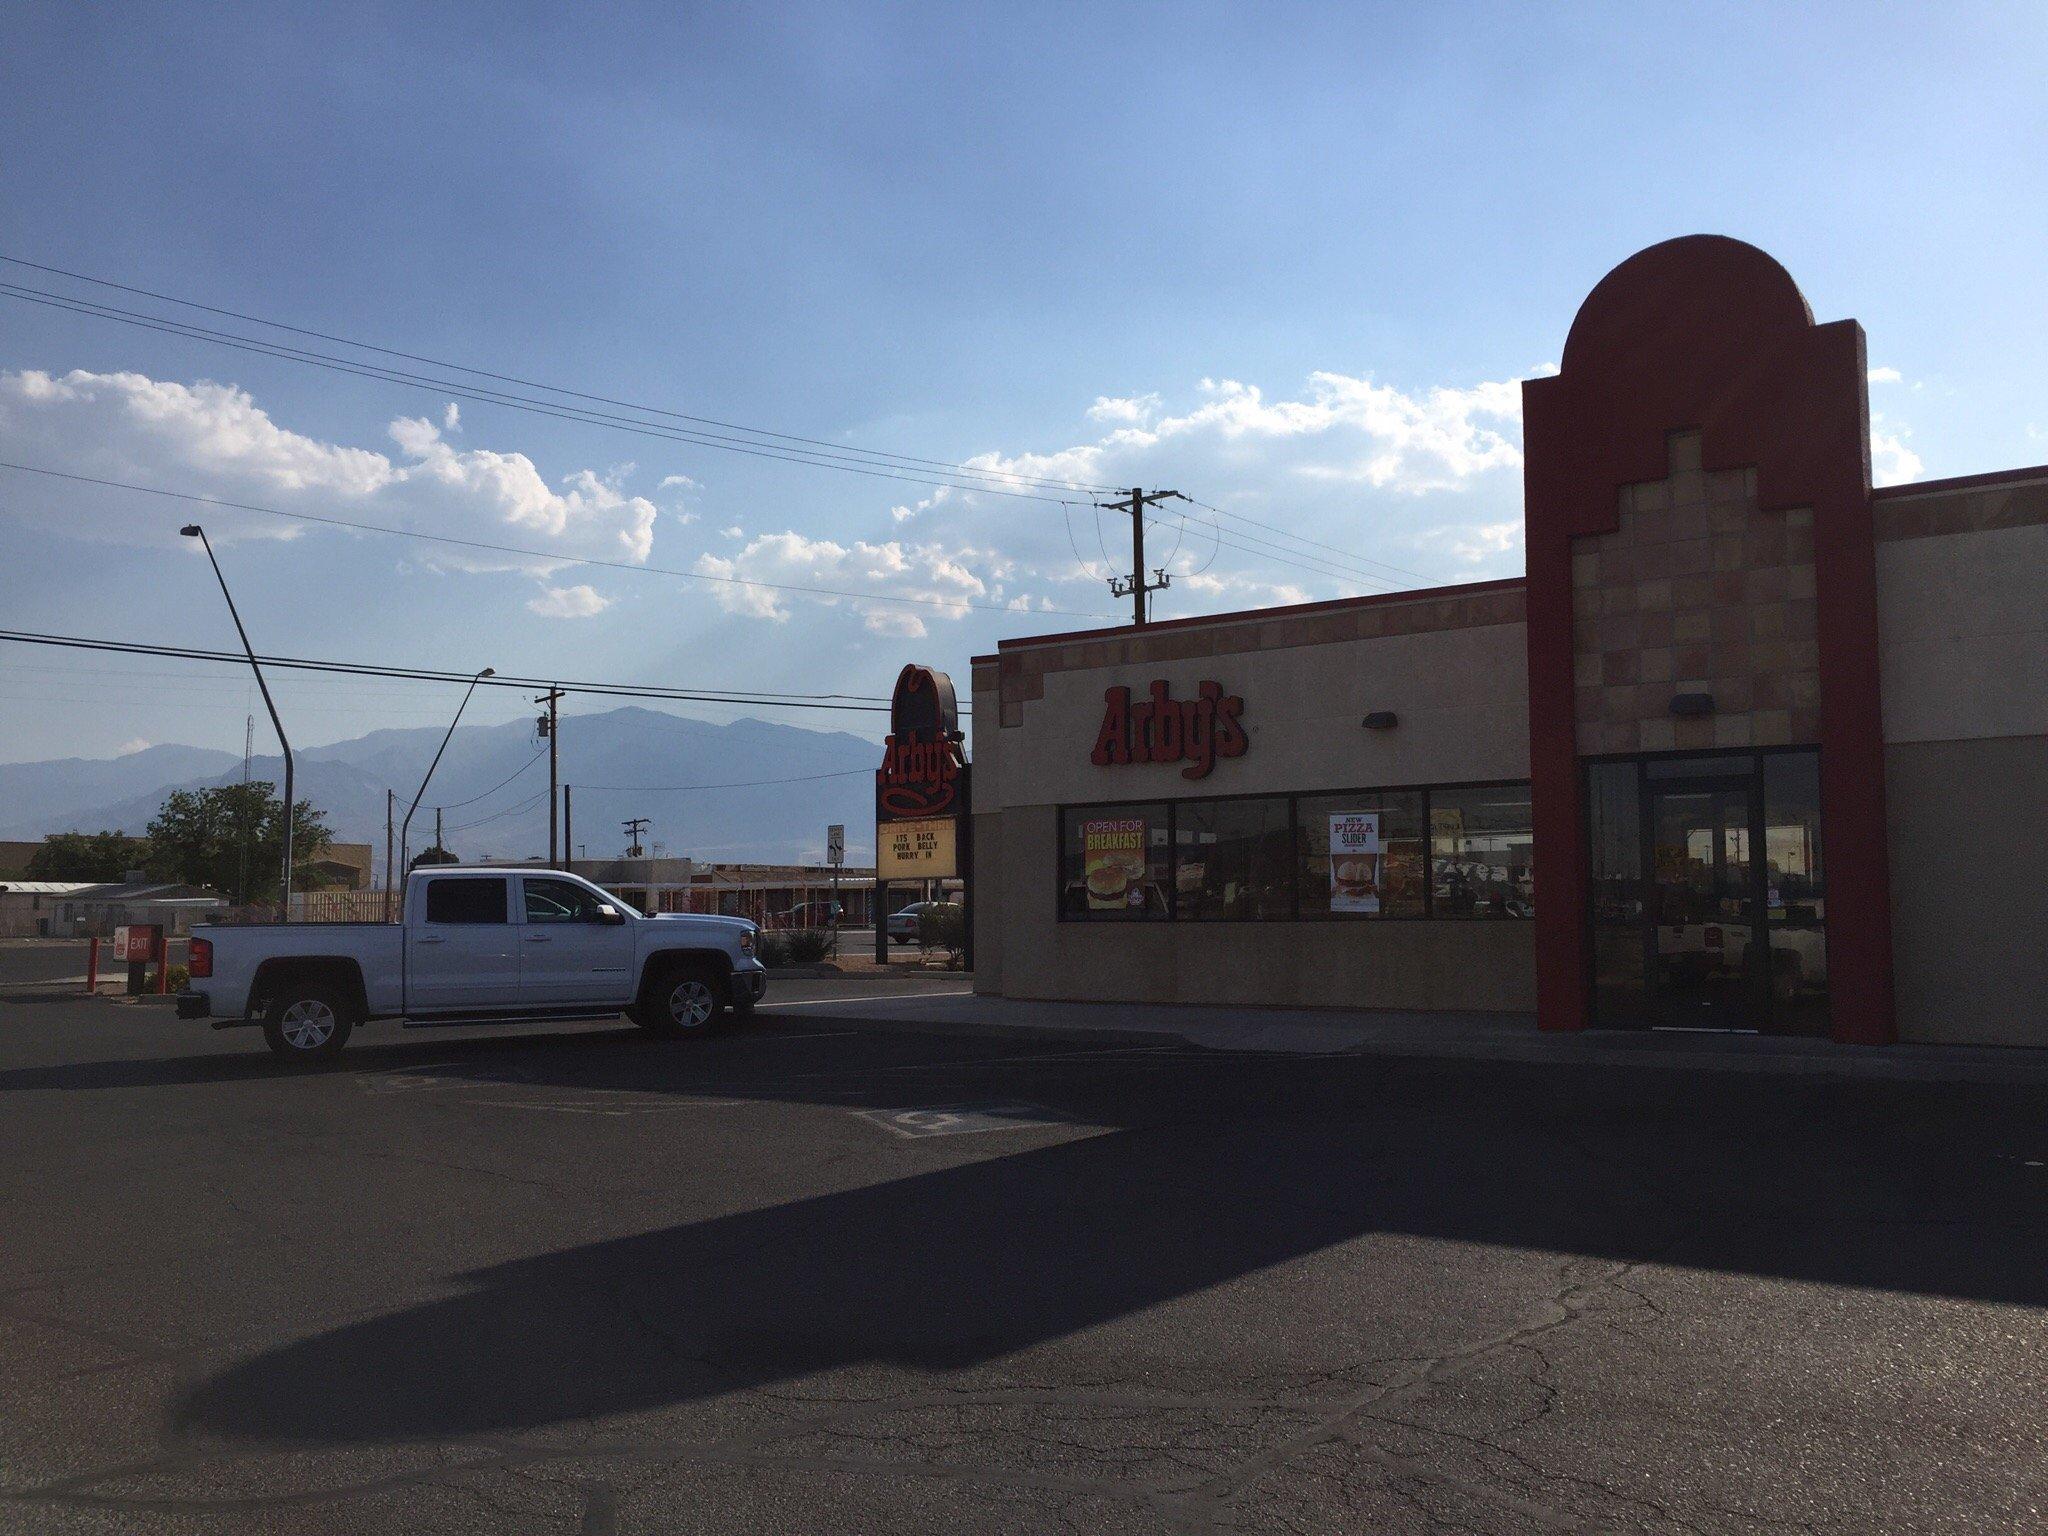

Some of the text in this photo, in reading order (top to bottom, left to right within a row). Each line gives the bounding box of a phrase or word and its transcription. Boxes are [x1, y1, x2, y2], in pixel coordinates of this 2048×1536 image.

[1091, 679, 1249, 779] Arby's
[877, 730, 961, 794] Arby's
[1087, 820, 1142, 833] OPEN FOR
[1334, 823, 1374, 833] PIZZA
[896, 833, 935, 843] ITS BACK
[1087, 832, 1143, 850] BREAKFAST
[1341, 833, 1367, 844] SLIDER
[893, 841, 938, 852] PORK BELLY
[925, 850, 932, 859] IN
[130, 937, 149, 949] EXIT
